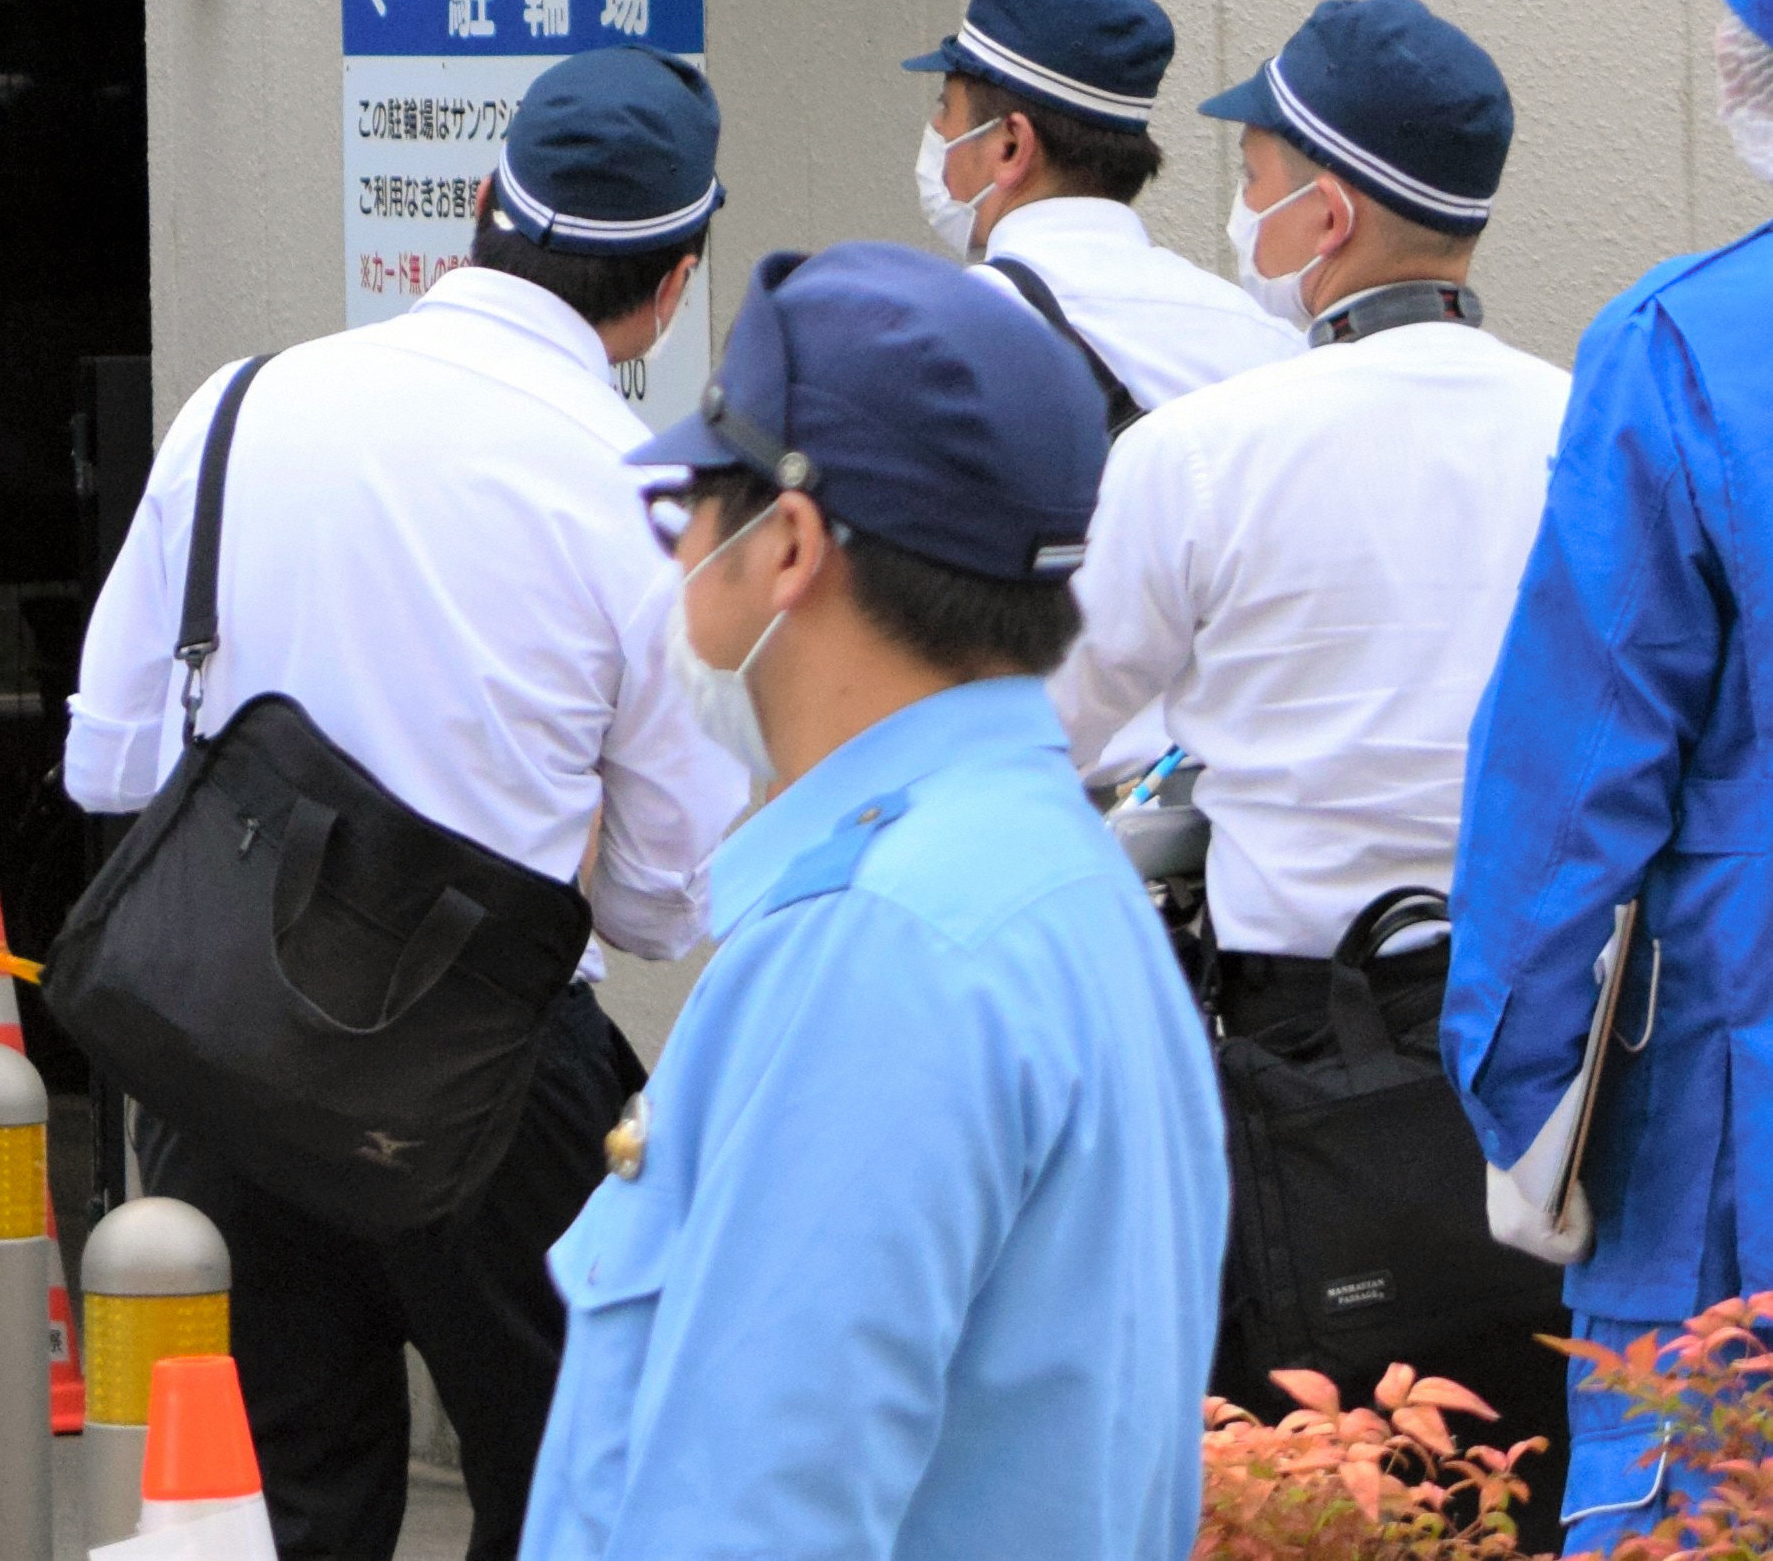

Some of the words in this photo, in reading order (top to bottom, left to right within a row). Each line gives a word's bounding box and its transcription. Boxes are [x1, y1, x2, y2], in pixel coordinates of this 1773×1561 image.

[358, 97, 522, 140] この駐輪場はサンワシ
